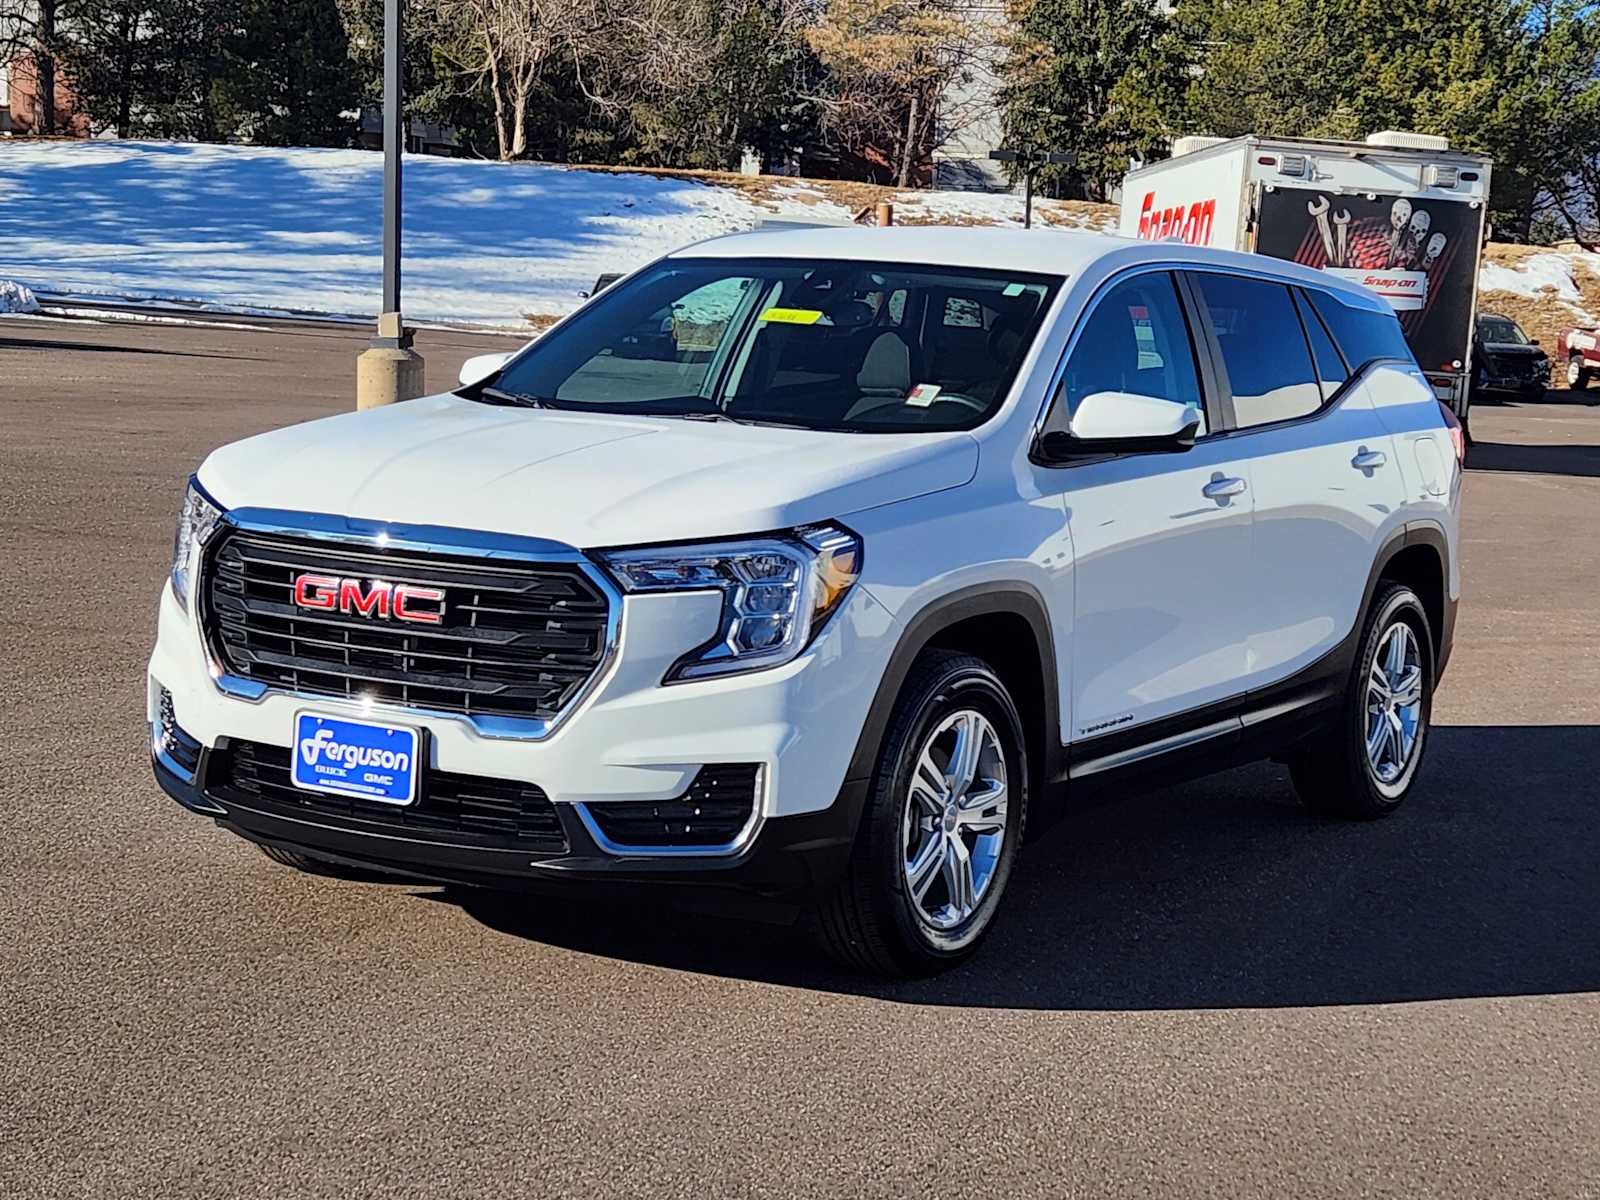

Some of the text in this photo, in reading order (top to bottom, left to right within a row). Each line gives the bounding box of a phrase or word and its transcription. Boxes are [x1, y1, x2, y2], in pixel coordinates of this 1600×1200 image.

[1363, 276, 1418, 288] Snap-on
[294, 573, 445, 624] GMC
[301, 729, 409, 772] Ferguson
[363, 772, 394, 786] GMC
